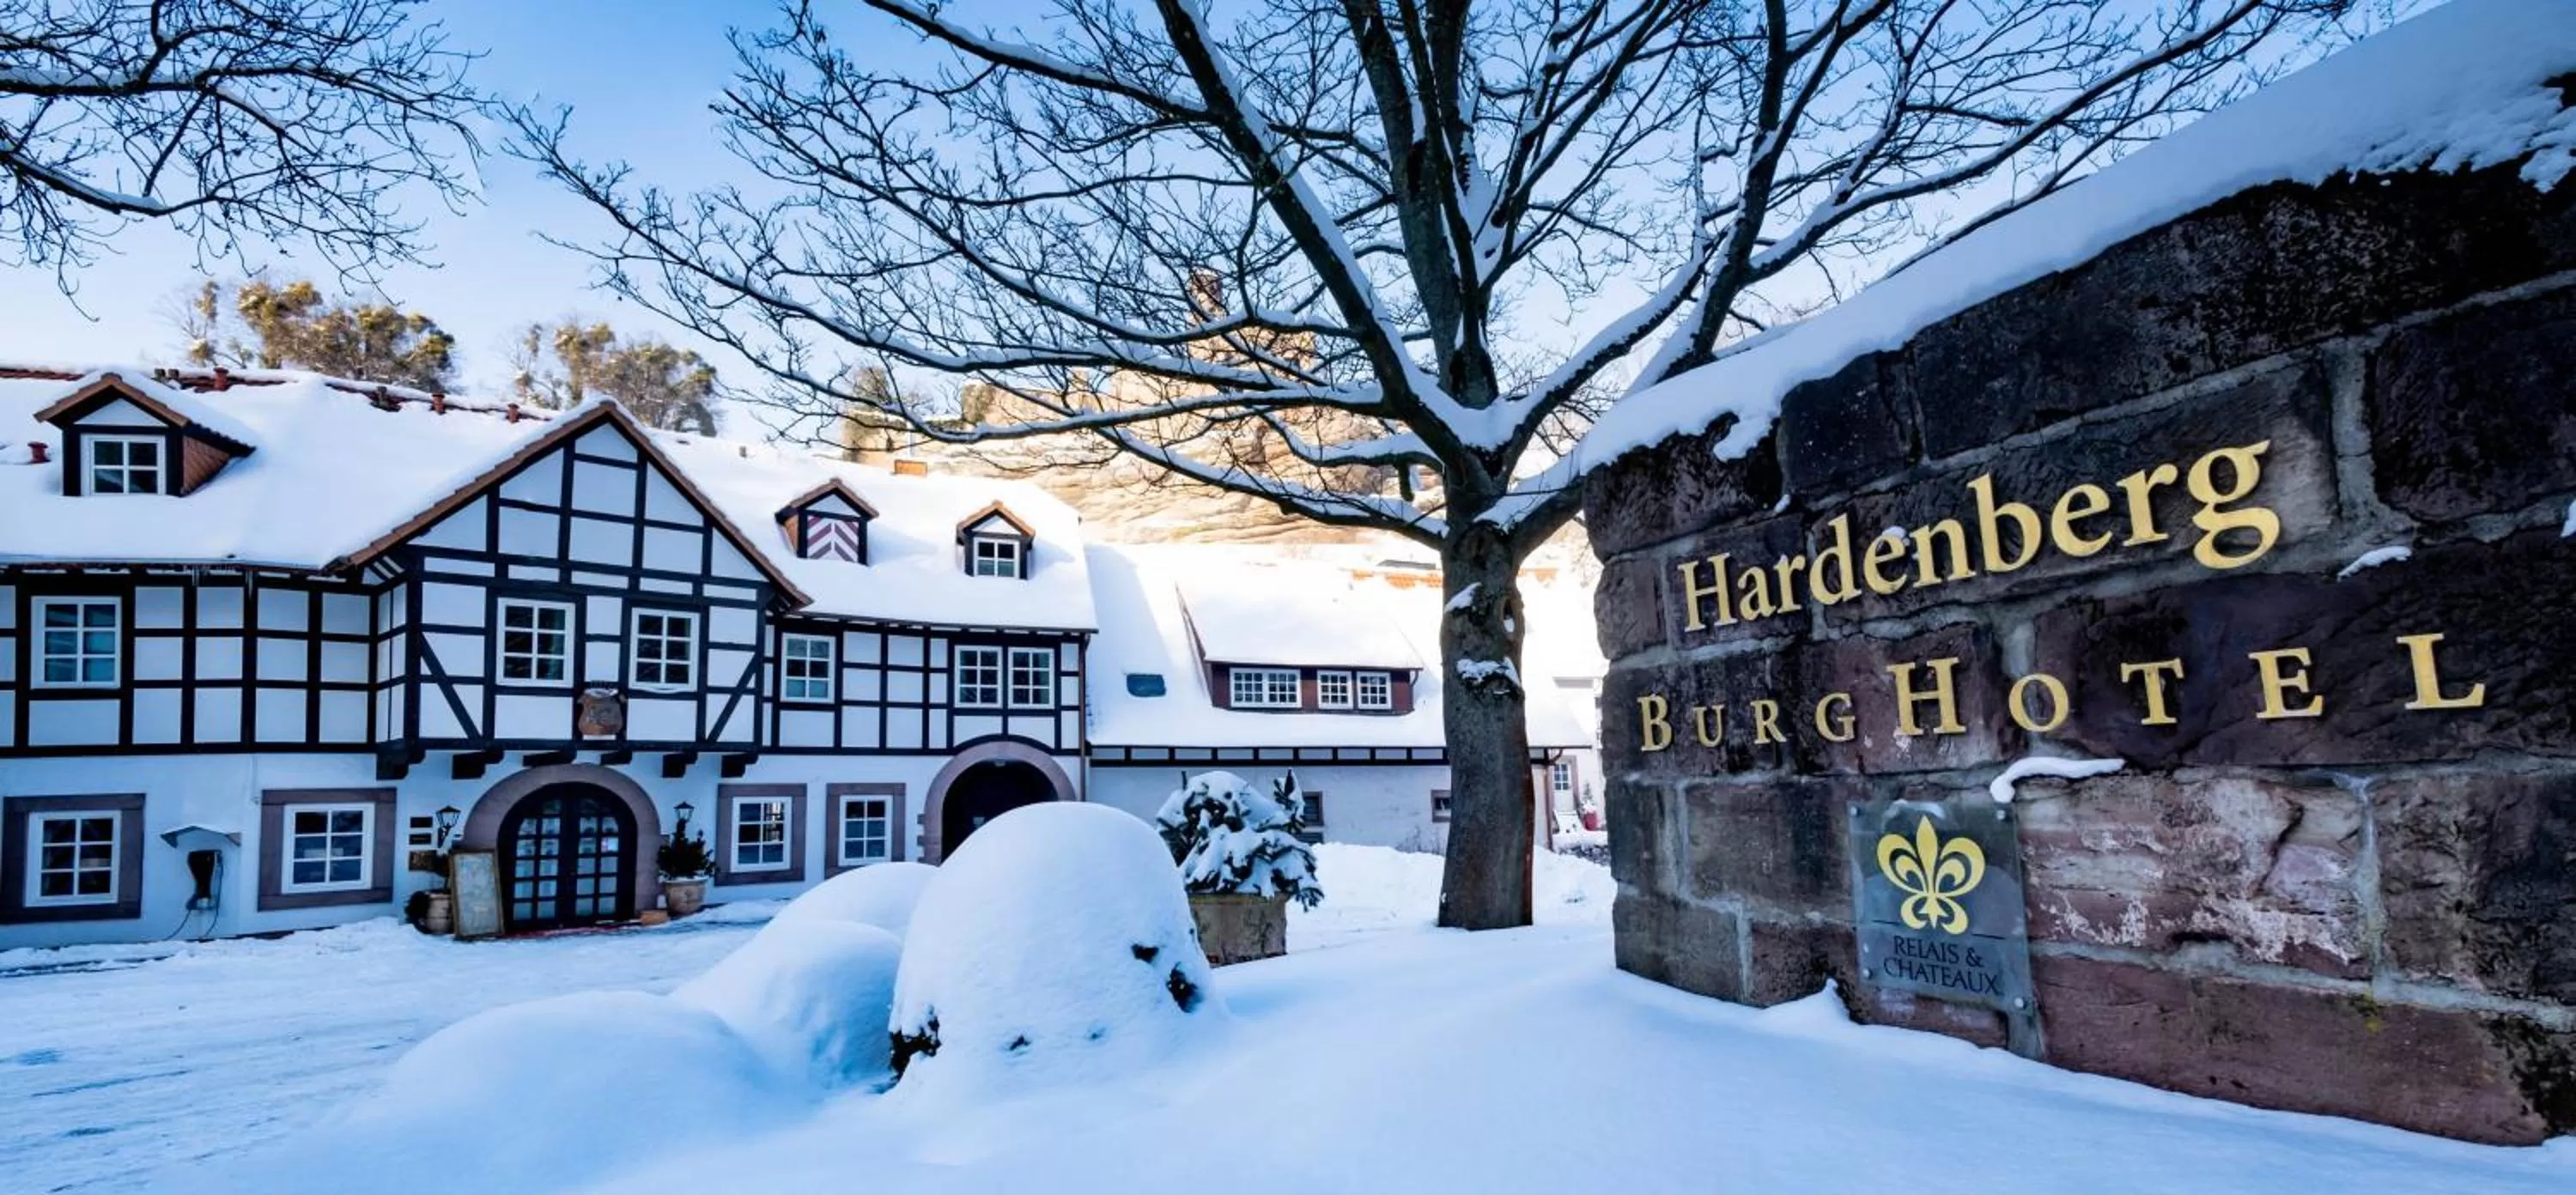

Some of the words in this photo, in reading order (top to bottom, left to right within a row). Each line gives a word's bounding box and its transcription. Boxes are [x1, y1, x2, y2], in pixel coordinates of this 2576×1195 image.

[1678, 440, 2281, 632] Hardenberg
[1894, 936, 1959, 965] RELAIS
[1965, 948, 1986, 968] &
[1884, 957, 2004, 997] CHATEAUX
